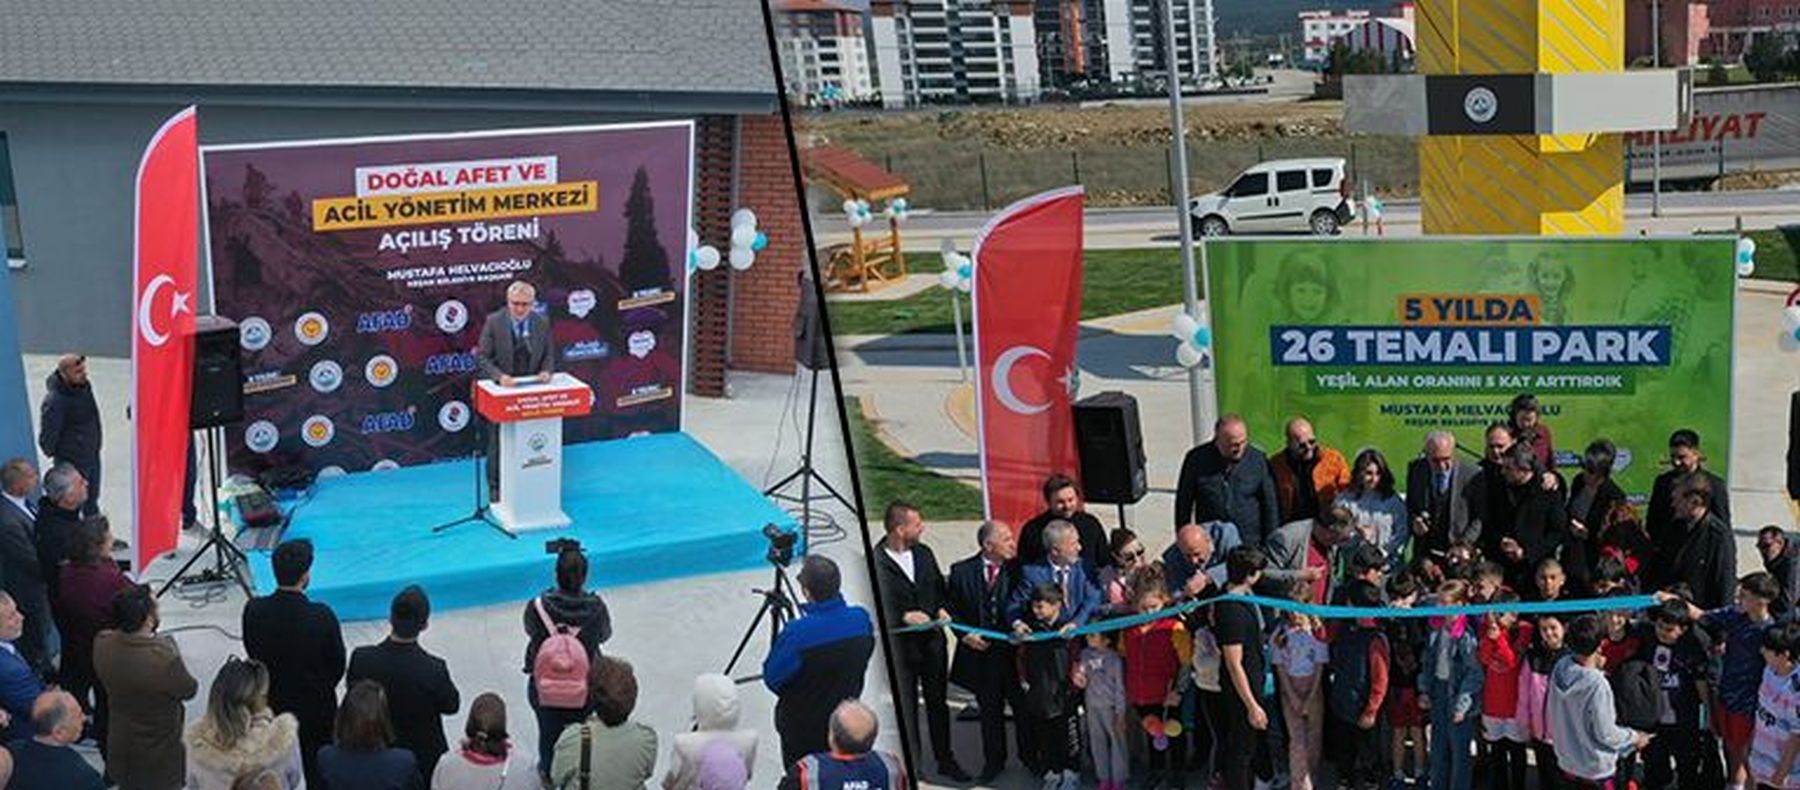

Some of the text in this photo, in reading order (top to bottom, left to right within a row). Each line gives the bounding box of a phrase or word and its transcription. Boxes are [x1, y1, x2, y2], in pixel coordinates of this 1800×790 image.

[367, 163, 547, 191] DOĞAL AFET VE
[324, 185, 589, 223] ACİL YÖNETİM MERKEZİ
[378, 217, 540, 253] AÇILIŞ TÖRENİ
[387, 258, 533, 280] MUSTAFA HELVACIOĞLU
[1405, 299, 1533, 321] 5 YILDA
[1281, 330, 1660, 363] 26 TEMALI PARK
[1316, 371, 1623, 391] YEŞİL ALAN ORANINI 5 KAT ARTTIRDIK
[1380, 404, 1561, 416] MUSTAFA HELVACLU
